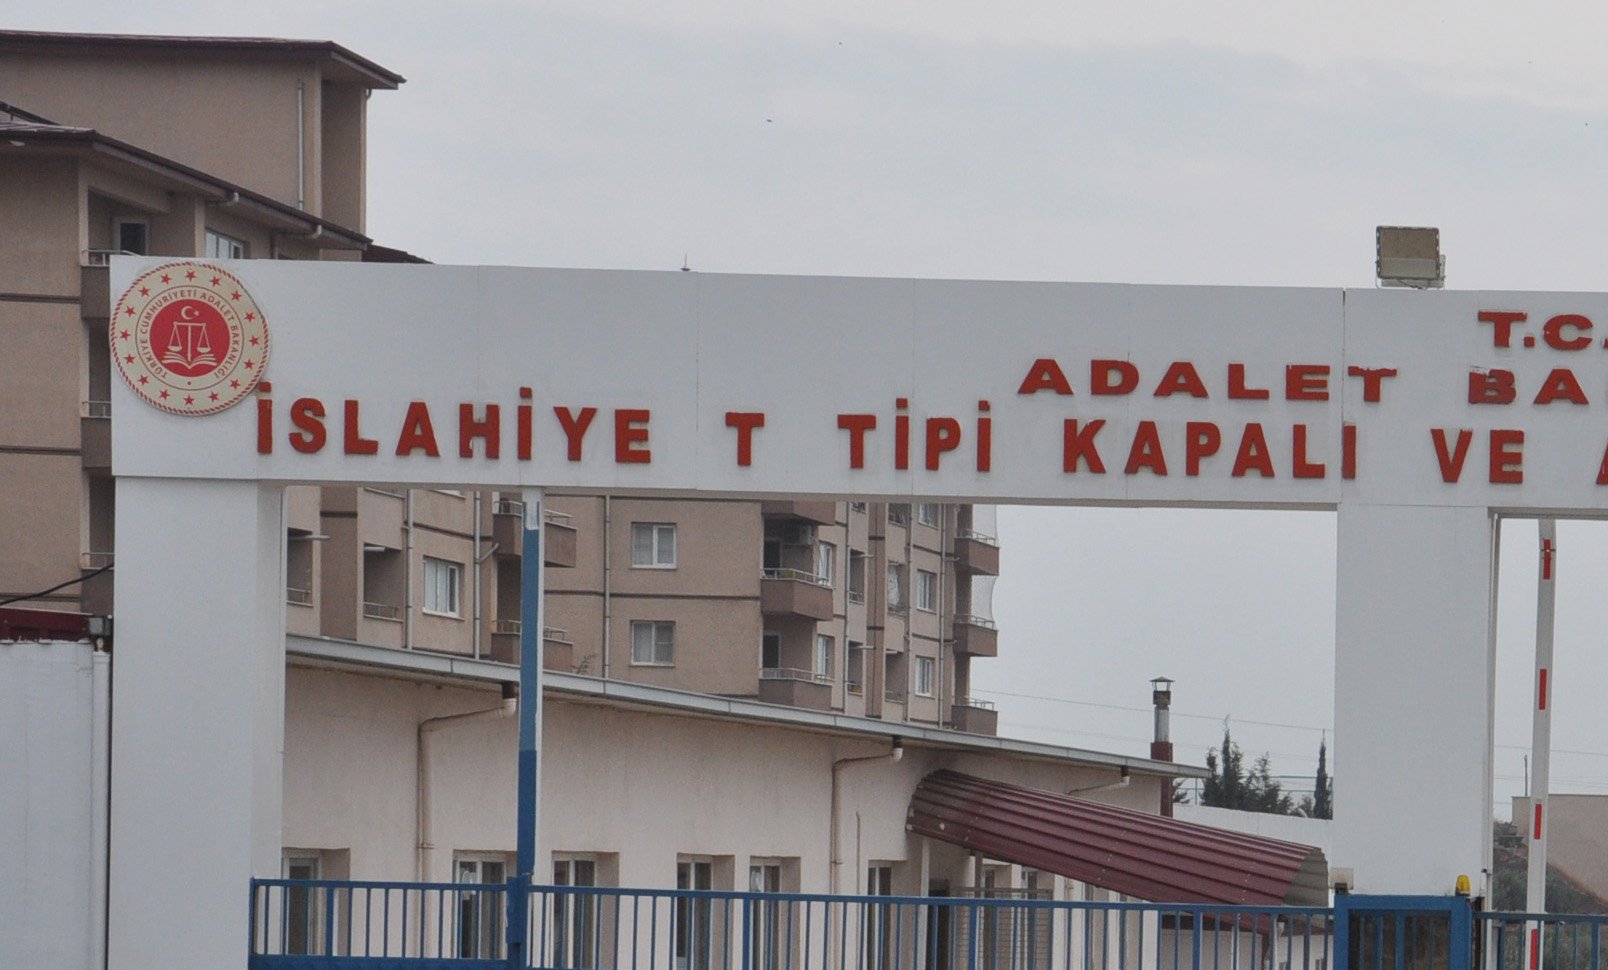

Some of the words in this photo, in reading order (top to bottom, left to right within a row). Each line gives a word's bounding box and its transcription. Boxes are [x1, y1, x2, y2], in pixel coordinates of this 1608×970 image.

[142, 289, 197, 335] CUMHURİYETİ
[201, 292, 234, 323] ADALET
[140, 337, 168, 378] TÜRKİYE
[214, 325, 240, 379] BAKANLIĞI
[1020, 358, 1397, 403] ADALET
[258, 380, 652, 463] İSLAHİYE
[726, 412, 766, 466] T
[838, 398, 992, 473] TİPİ
[1063, 418, 1359, 479] KAPALI
[1431, 428, 1526, 486] VE
